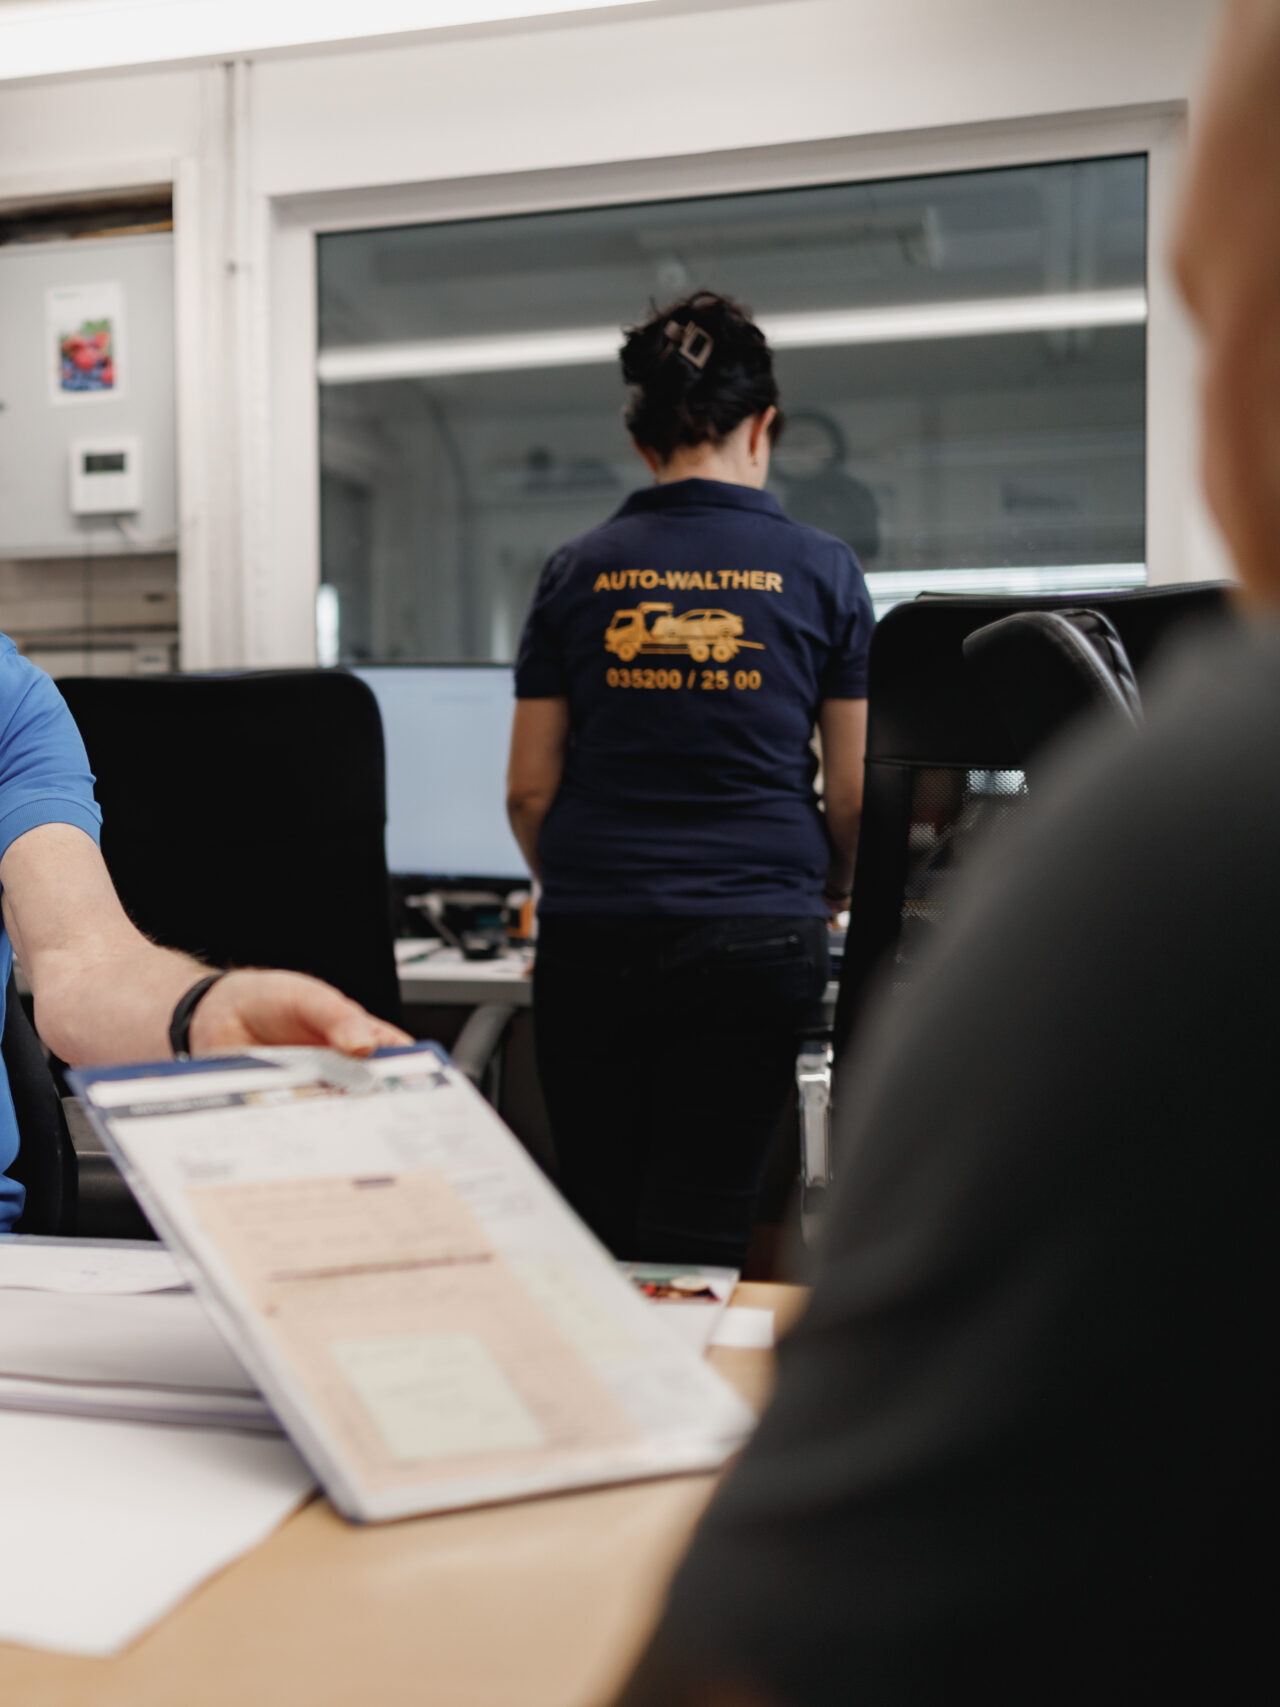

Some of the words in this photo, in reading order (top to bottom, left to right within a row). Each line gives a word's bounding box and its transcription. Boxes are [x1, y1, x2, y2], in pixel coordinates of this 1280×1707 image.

[593, 569, 784, 593] AUTO-WALTHER
[606, 668, 682, 690] 035200
[687, 668, 696, 690] /
[701, 669, 729, 690] 25
[734, 669, 762, 690] 00
